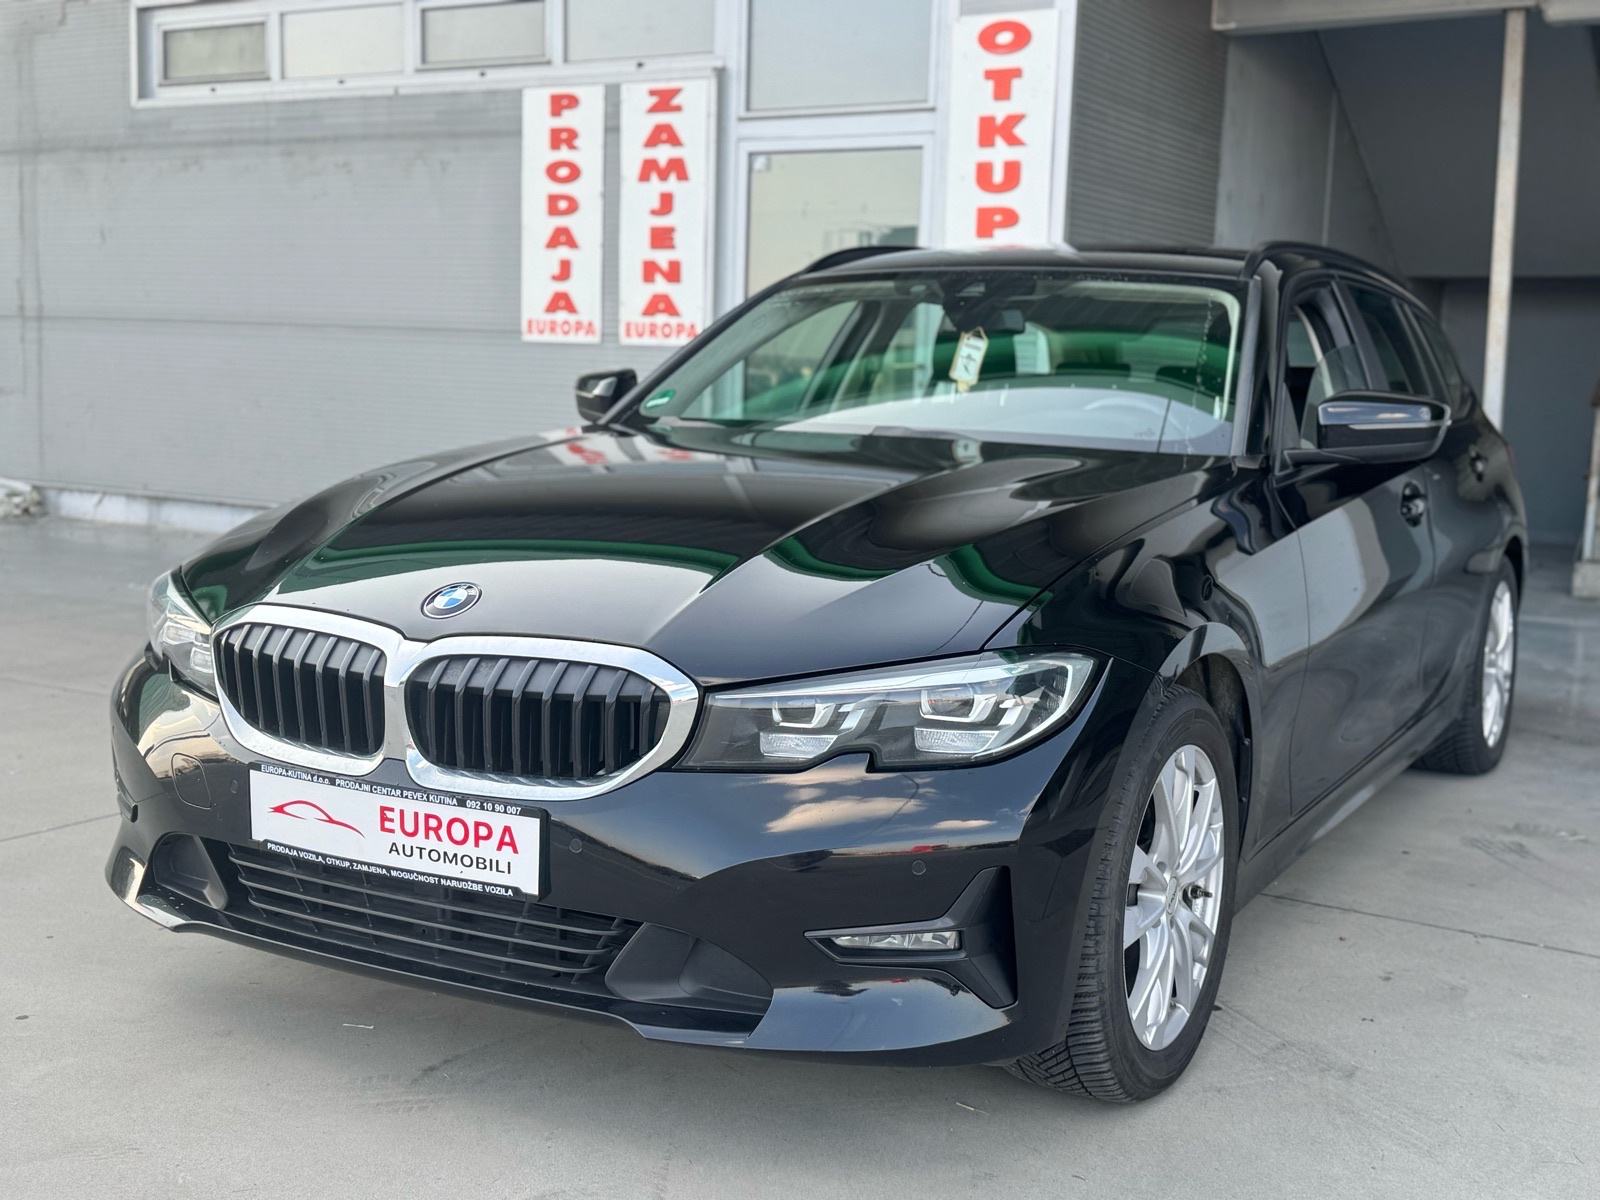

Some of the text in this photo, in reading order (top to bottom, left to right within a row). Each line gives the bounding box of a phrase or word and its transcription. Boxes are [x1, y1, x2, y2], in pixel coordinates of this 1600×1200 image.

[976, 20, 1032, 239] OTKUP
[544, 93, 582, 315] PRODAJA
[637, 88, 689, 317] ZAMJENA
[526, 318, 596, 336] EUROPA
[624, 321, 698, 339] EUROPA
[261, 765, 312, 782] EUROPA-KUTINA
[335, 779, 371, 793] PRODAJNI
[372, 785, 401, 798] CENTAR
[403, 790, 428, 802] PEVEX
[429, 794, 458, 806] KUTINA
[466, 799, 481, 810] 092
[483, 802, 493, 811] 10
[494, 804, 505, 813] 90
[506, 806, 522, 816] 007
[379, 805, 519, 855] EUROPA
[267, 842, 298, 857] PRODAJA
[298, 851, 325, 864] VOZILA,
[326, 857, 352, 869] OTKUP,
[352, 862, 390, 876] ZAMJENA,
[484, 885, 514, 897] VOZILA
[388, 842, 511, 875] AUTOMOBILI
